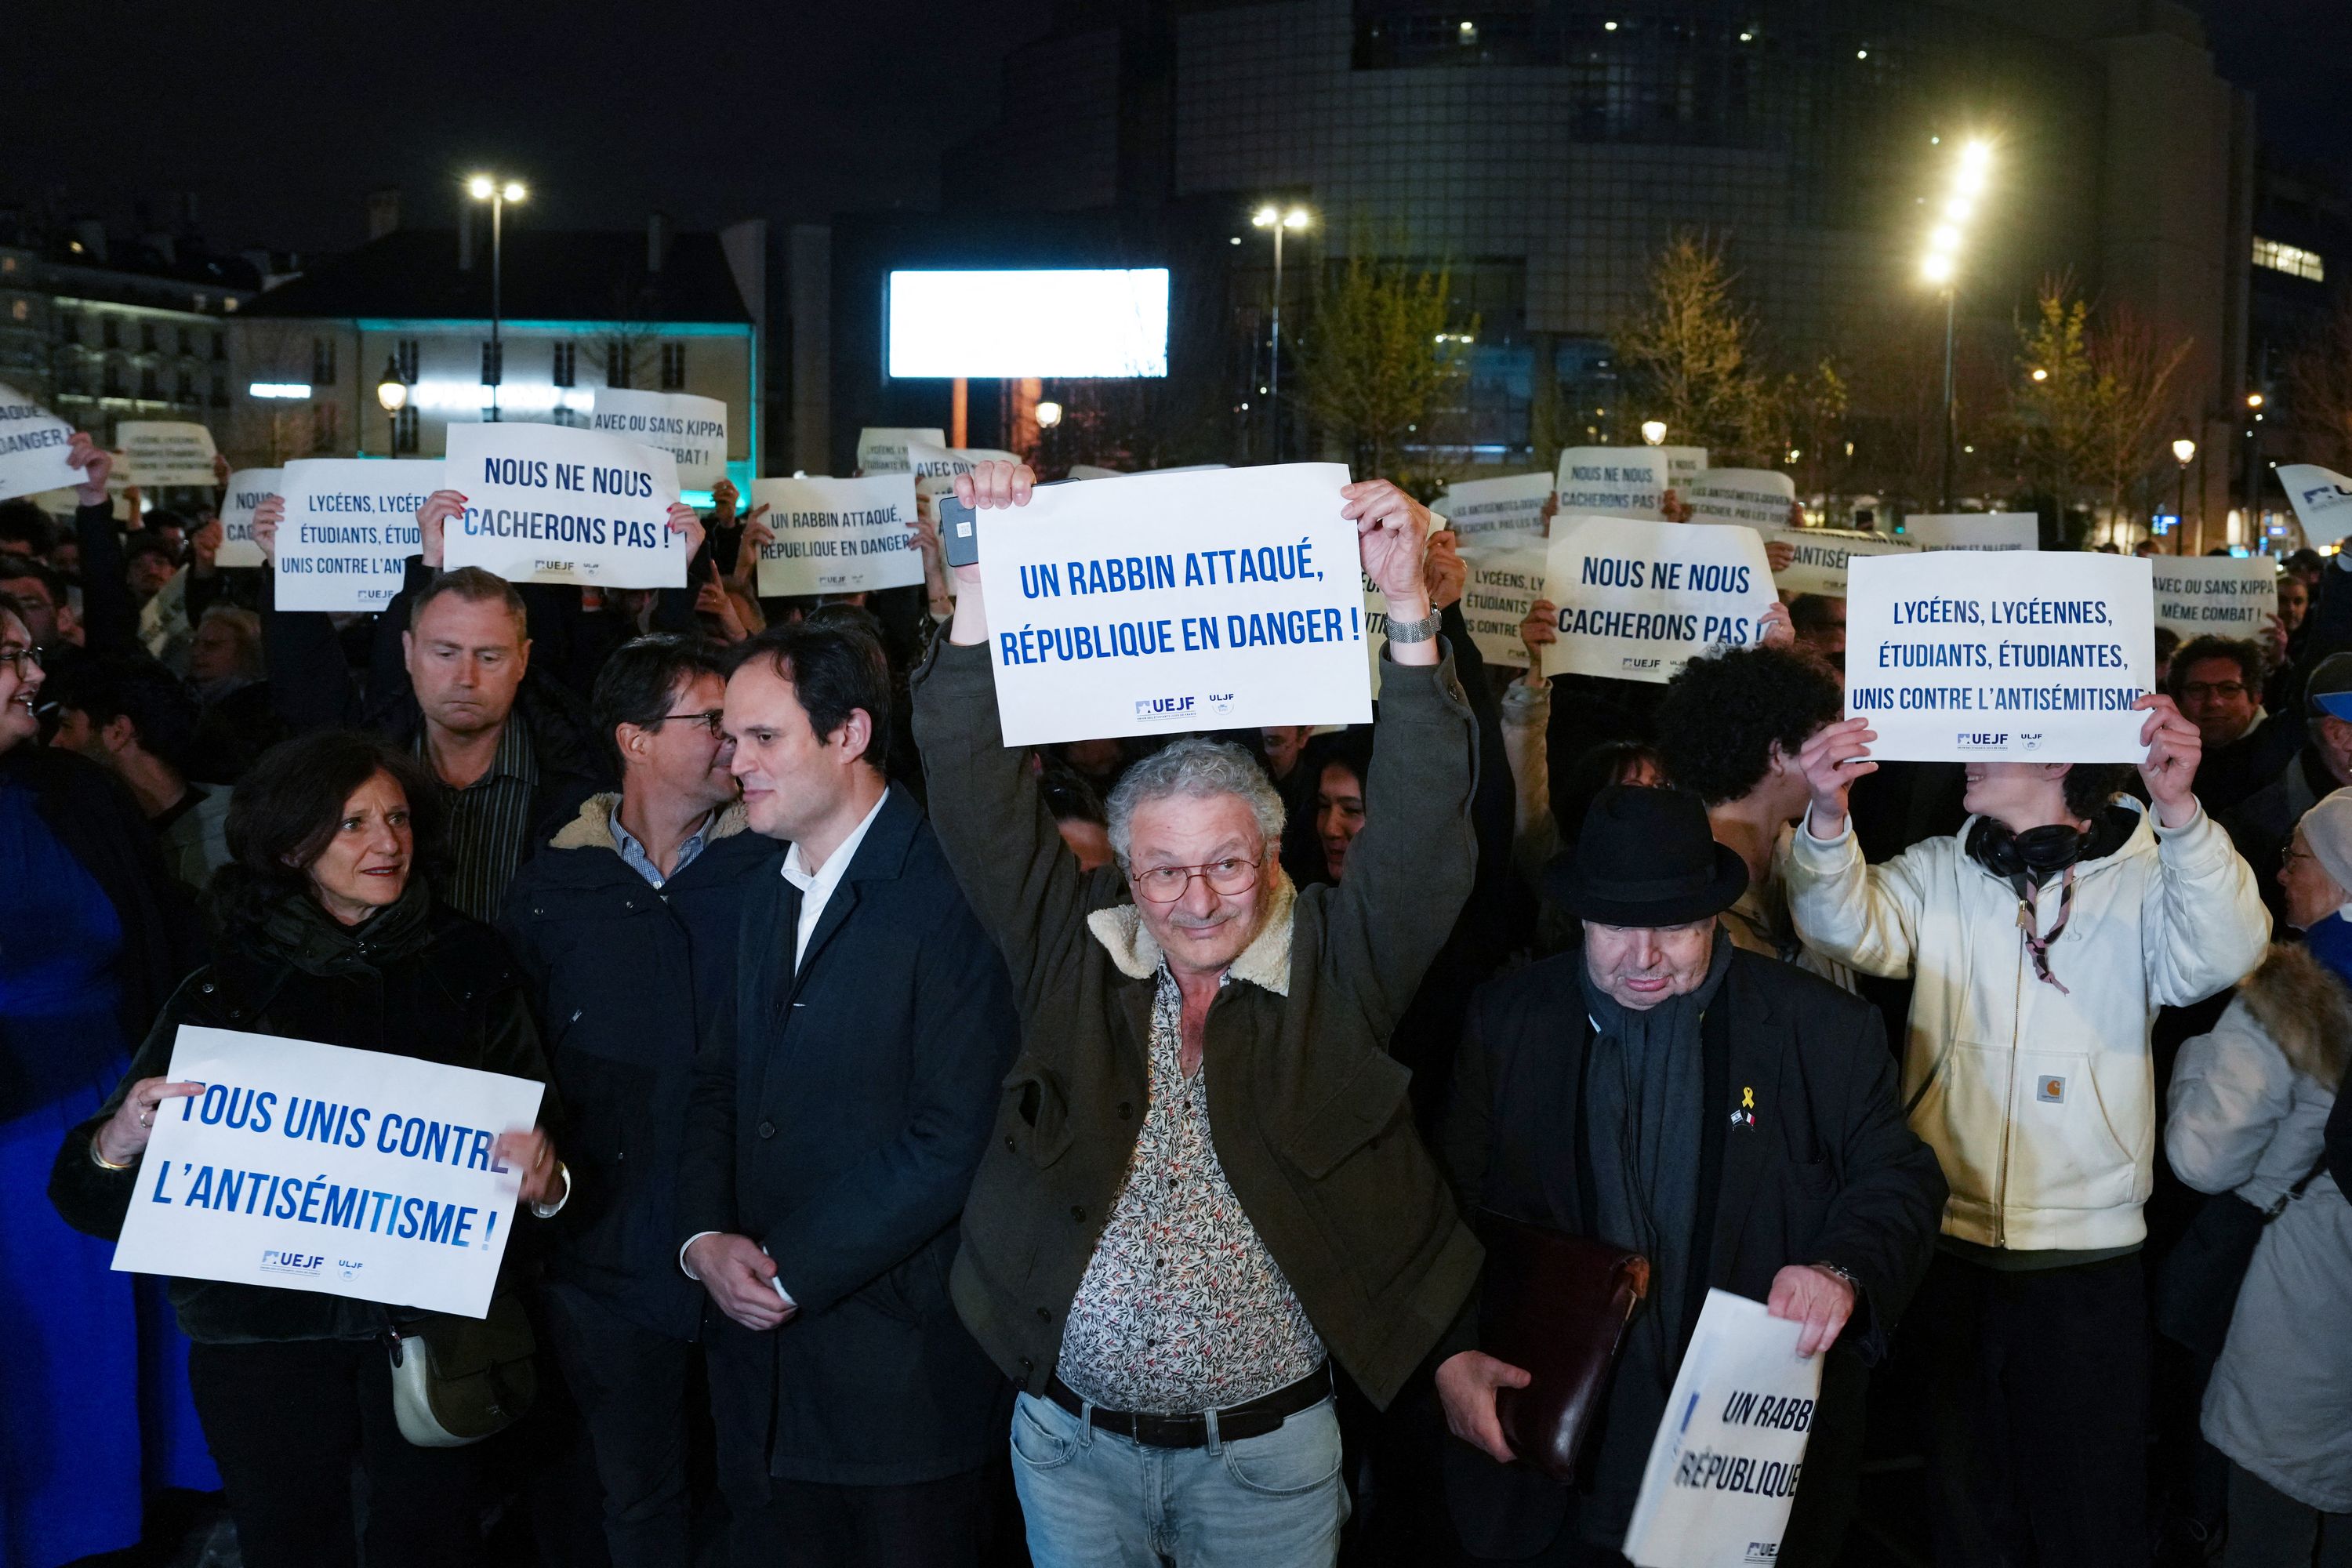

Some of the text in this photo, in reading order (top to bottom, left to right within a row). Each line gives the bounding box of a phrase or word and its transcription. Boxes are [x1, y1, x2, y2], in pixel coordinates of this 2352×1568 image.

[595, 414, 724, 439] AVEC OU SANS KIPPA
[705, 450, 709, 466] !
[485, 457, 652, 498] NOUS NE NOUS
[916, 461, 951, 478] AVEC
[1571, 466, 1602, 483] NOUS
[1604, 466, 1621, 483] NE
[1622, 467, 1653, 484] NOUS
[309, 492, 376, 514] LYCÉENS,
[1561, 492, 1629, 508] CACHERONS
[1632, 493, 1655, 509] PAS
[771, 503, 902, 529] UN RABBIN ATTAQUÉ,
[300, 523, 381, 546] ÉTUDIANTS,
[464, 507, 670, 549] CACHERONS PAS !
[760, 534, 909, 560] RÉPUBLIQUE EN DANGER
[282, 557, 313, 574] UNIS
[317, 557, 368, 574] CONTRE
[546, 561, 575, 571] UEJF
[1020, 563, 1061, 600] UN
[1068, 554, 1175, 596] RABBIN
[1185, 536, 1324, 587] ATTAQUÉ,
[1581, 556, 1750, 593] NOUS NE NOUS
[1475, 570, 1528, 591] LYCÉENS,
[2152, 579, 2275, 594] AVEC OU SANS KIPPA
[368, 590, 394, 599] UEJF
[1893, 596, 2113, 626] LYCÉENS, LYCÉENNES,
[2161, 602, 2262, 622] MÊME COMBAT !
[1000, 623, 1175, 666] RÉPUBLIQUE
[1181, 616, 1220, 652] EN
[1227, 608, 1344, 648] DANGER
[1350, 607, 1359, 641] !
[1477, 620, 1517, 637] CONTRE
[1558, 608, 1697, 641] CACHERONS
[1703, 616, 1748, 645] PAS
[1633, 659, 1661, 668] UEJF
[1879, 640, 2129, 670] ÉTUDIANTS, ÉTUDIANTES,
[1152, 693, 1234, 713] UEJF ULJF
[1853, 688, 1894, 710] UNIS
[1900, 687, 1973, 710] CONTRE
[1973, 733, 2009, 744] UEJF
[183, 1080, 510, 1174] TOUS UNIS CONTRE
[151, 1160, 498, 1251] L'ANTISÉMITISME !
[281, 1252, 363, 1269] UEJF ULJF
[1722, 1390, 1759, 1427] UN
